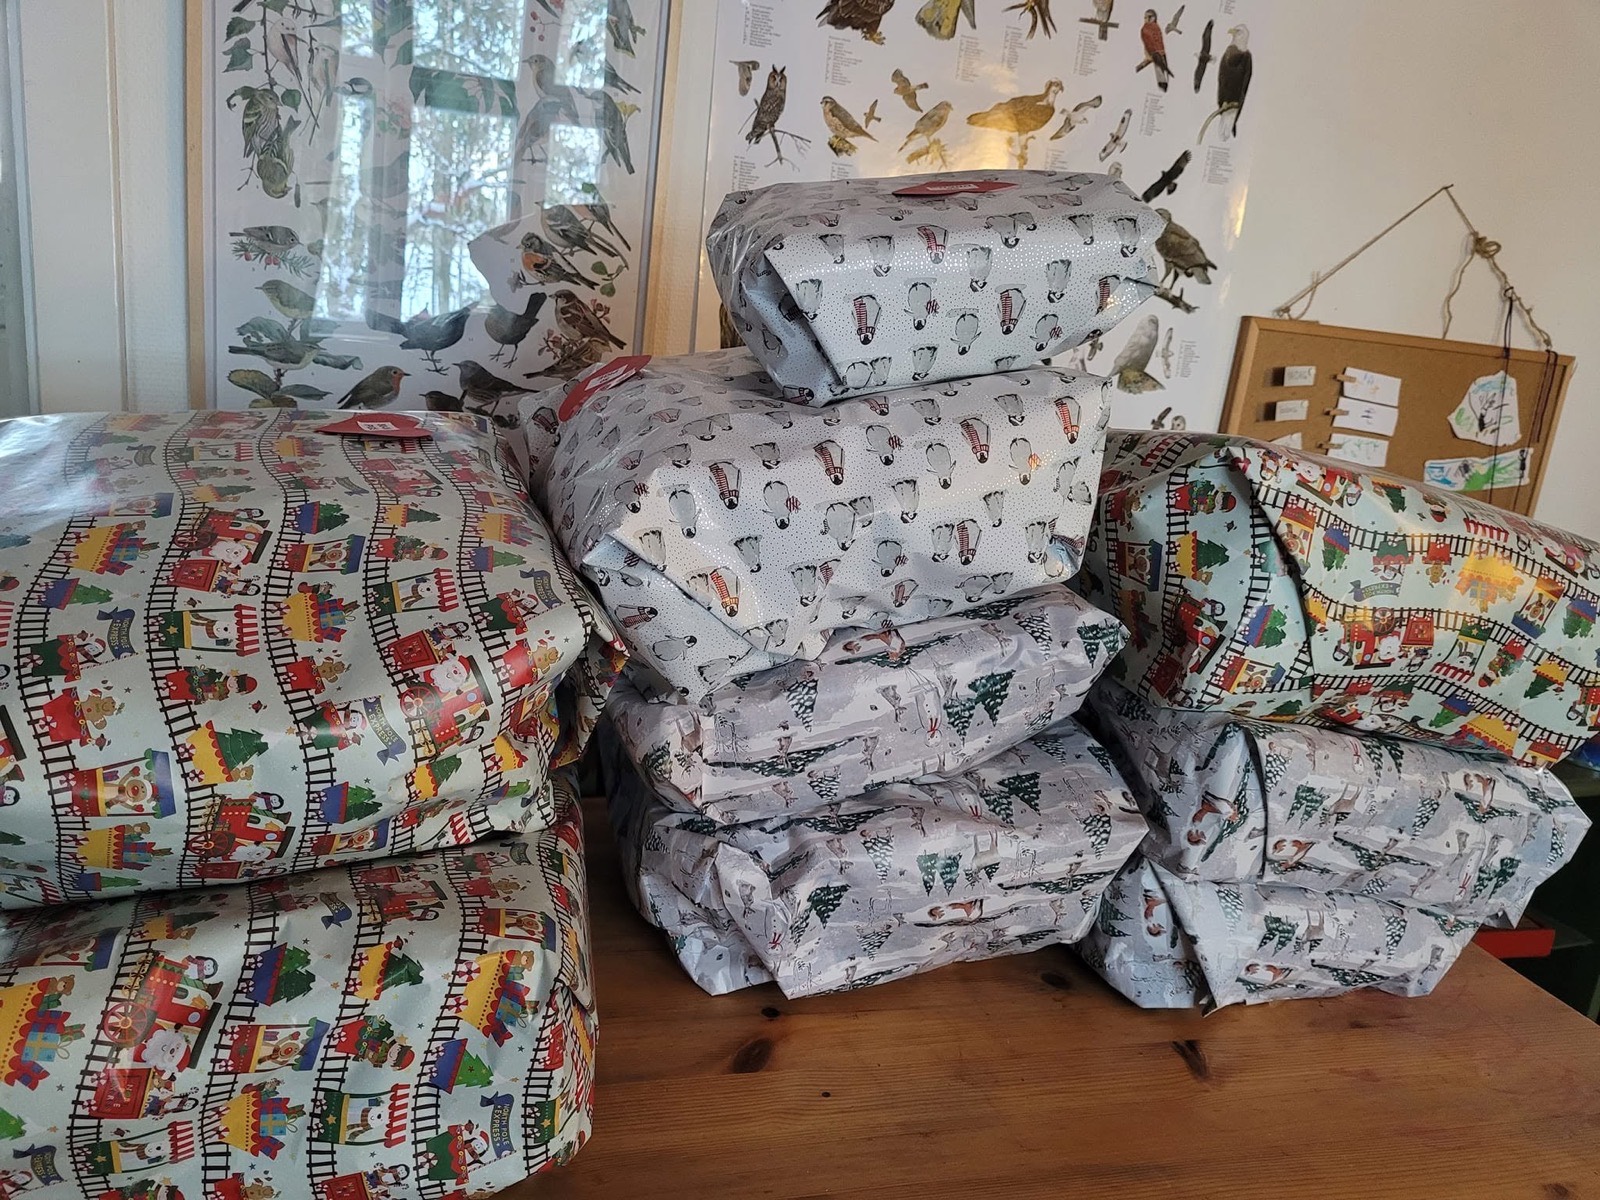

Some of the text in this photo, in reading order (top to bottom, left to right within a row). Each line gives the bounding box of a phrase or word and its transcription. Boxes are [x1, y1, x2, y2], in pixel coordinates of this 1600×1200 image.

[534, 580, 547, 600] EXPRESS
[110, 623, 120, 646] EXPRESS
[120, 618, 130, 648] NORTH POLE
[368, 713, 391, 743] EXPRESS
[374, 704, 398, 743] NORTH POLE
[492, 1109, 501, 1141] EXPRESS
[500, 1104, 510, 1145] NORTH POLE
